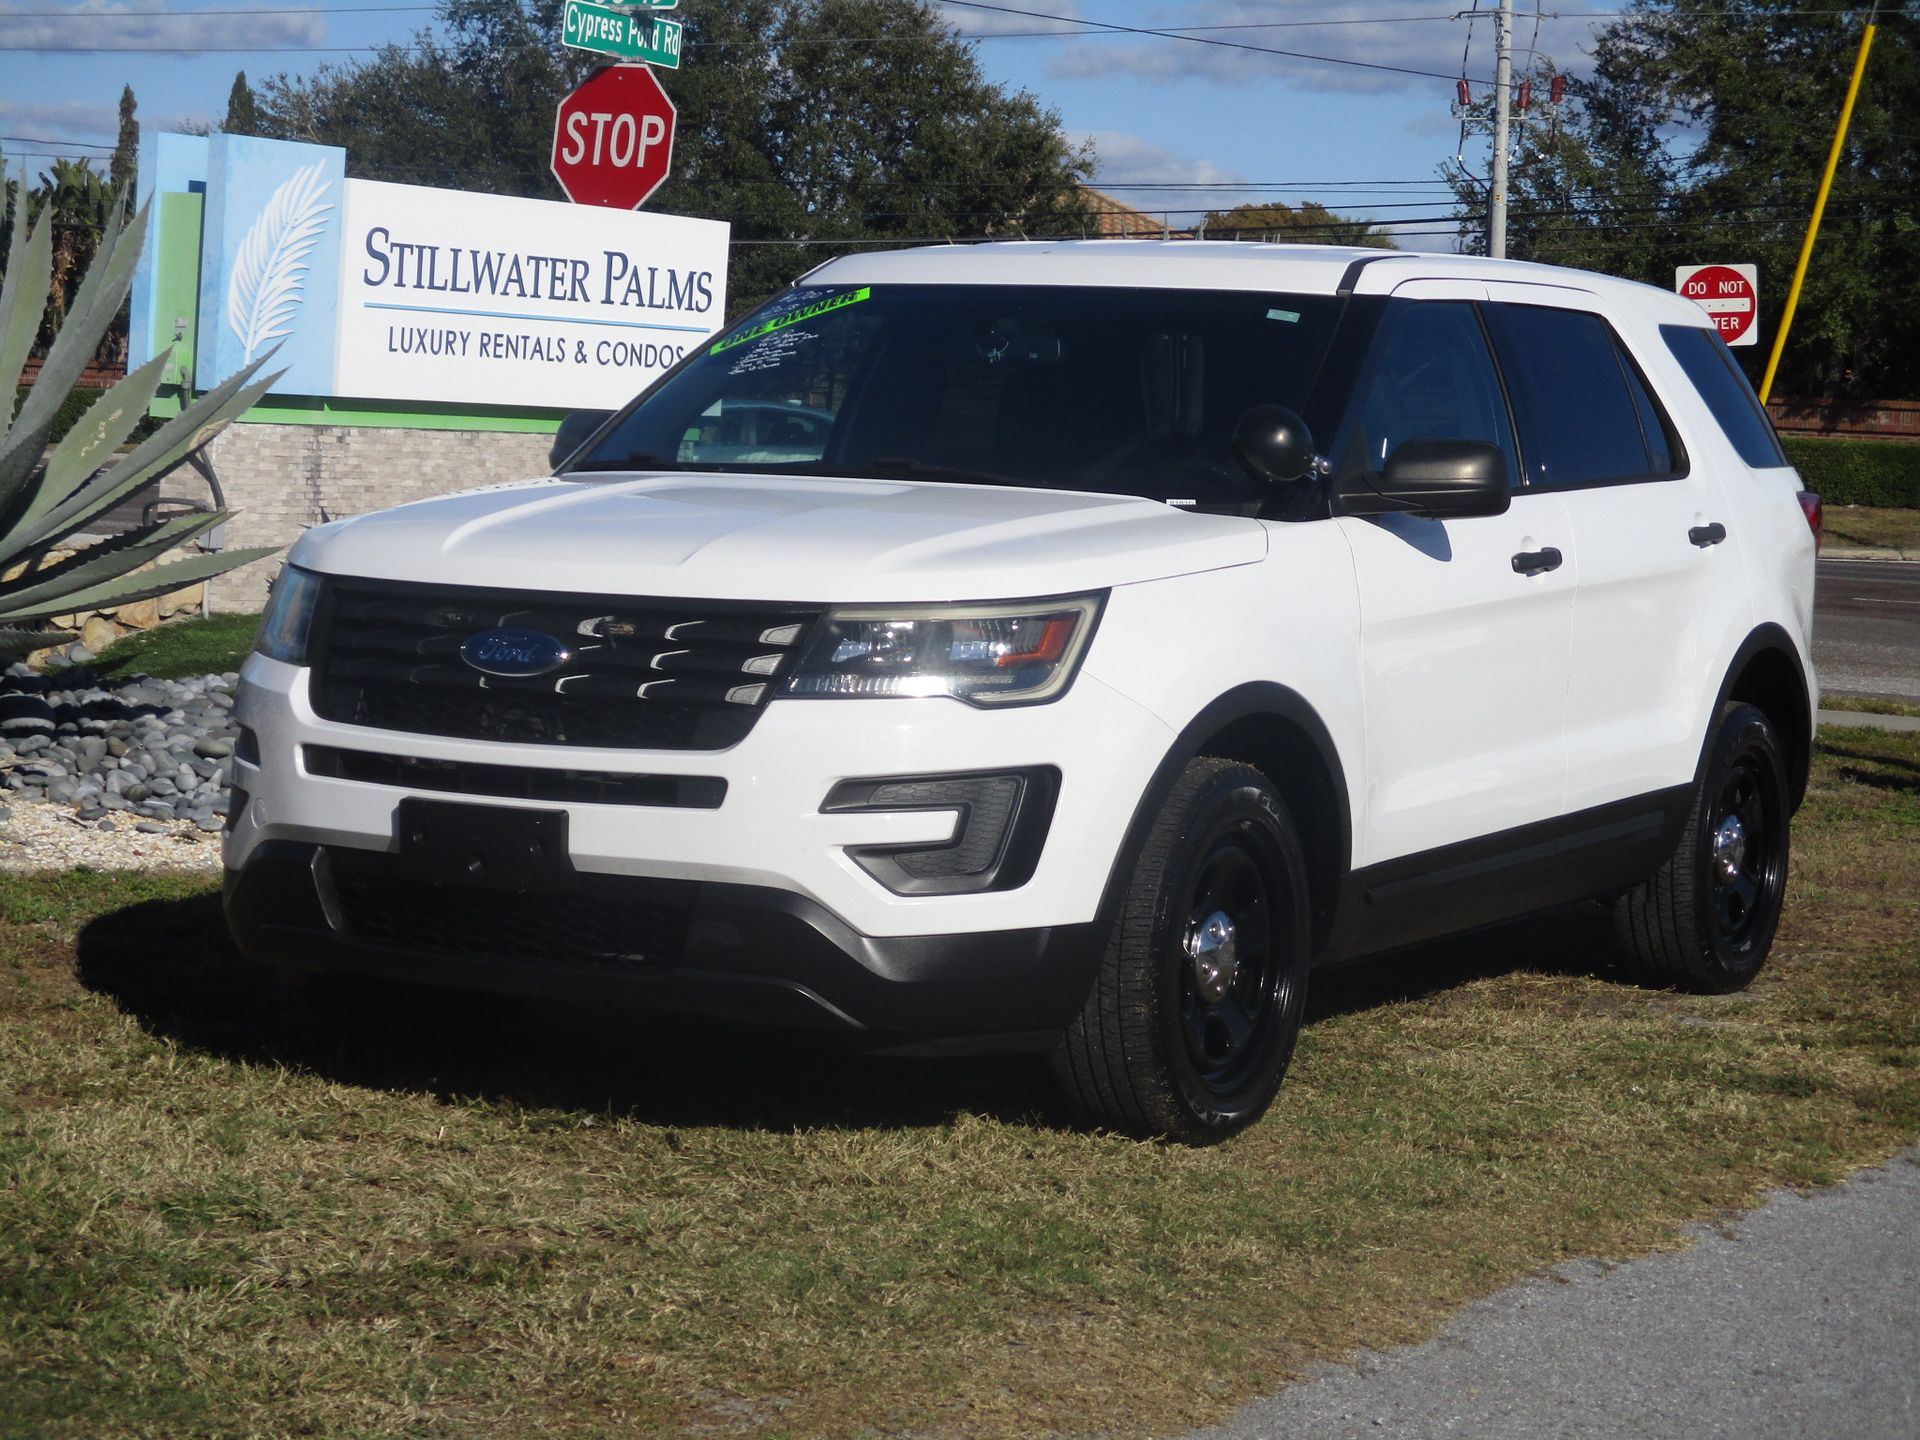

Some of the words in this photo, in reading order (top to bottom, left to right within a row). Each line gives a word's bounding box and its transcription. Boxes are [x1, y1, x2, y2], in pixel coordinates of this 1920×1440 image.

[567, 4, 623, 43] Cypress
[663, 25, 679, 56] Rd
[562, 111, 666, 168] STOP
[363, 227, 591, 303] STILLWATER
[600, 251, 713, 313] PALMS
[1688, 282, 1707, 295] DO
[1718, 281, 1745, 294] NOT
[720, 323, 769, 348] ONE
[773, 291, 860, 326] OWNER
[1712, 317, 1739, 330] TER
[388, 326, 471, 357] LUXURY
[479, 333, 566, 364] RENTALS
[574, 340, 588, 364] &
[478, 637, 542, 662] Ford
